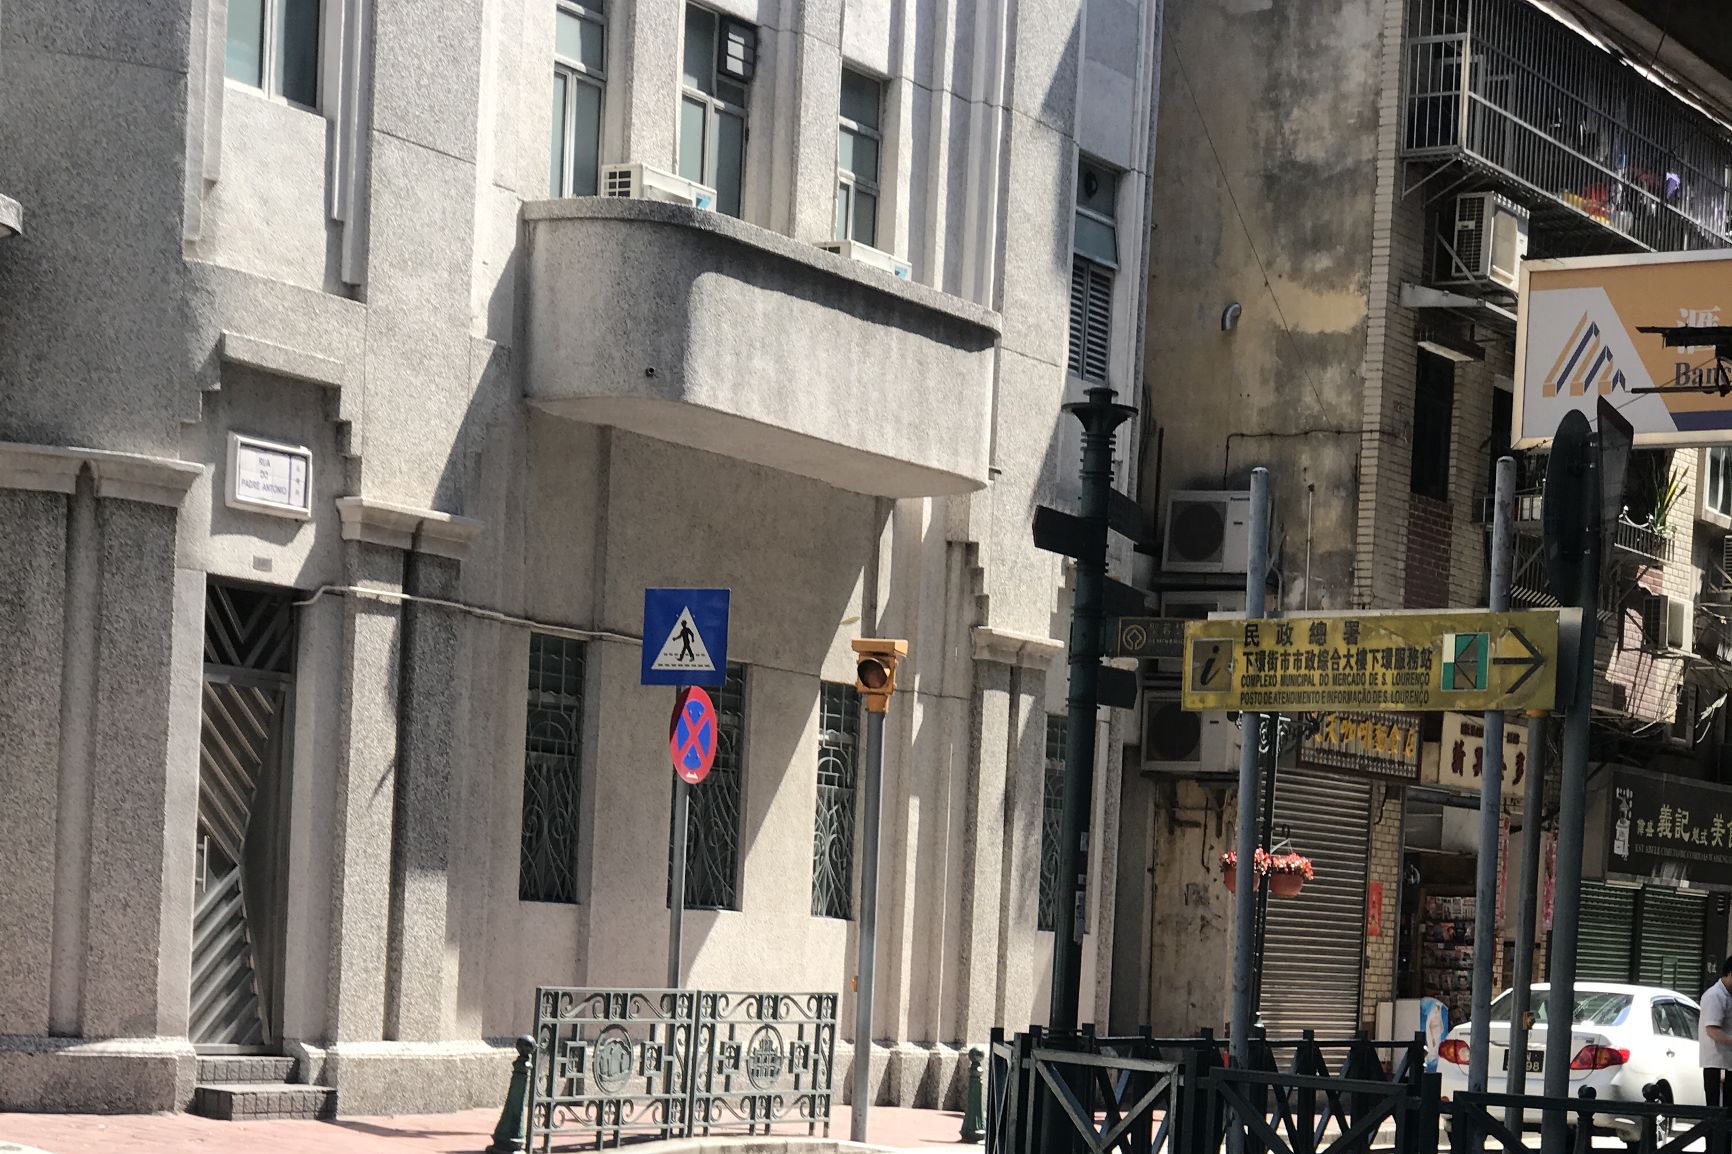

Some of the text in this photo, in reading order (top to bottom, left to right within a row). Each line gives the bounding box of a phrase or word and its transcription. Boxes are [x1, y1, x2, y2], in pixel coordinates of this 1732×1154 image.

[1244, 621, 1360, 647] 民政總署
[1241, 674, 1278, 688] COMPLEXO
[1280, 673, 1315, 688] MUNICIPAL
[1319, 673, 1329, 687] DO
[1332, 672, 1366, 687] MERCADO
[1369, 672, 1378, 686] DE
[1392, 672, 1430, 689] LOURENÇO
[1240, 692, 1263, 705] POSTO
[1263, 691, 1273, 704] DE
[1273, 691, 1320, 704] ATENDIMENTO
[1391, 690, 1430, 706] LOURENÇO
